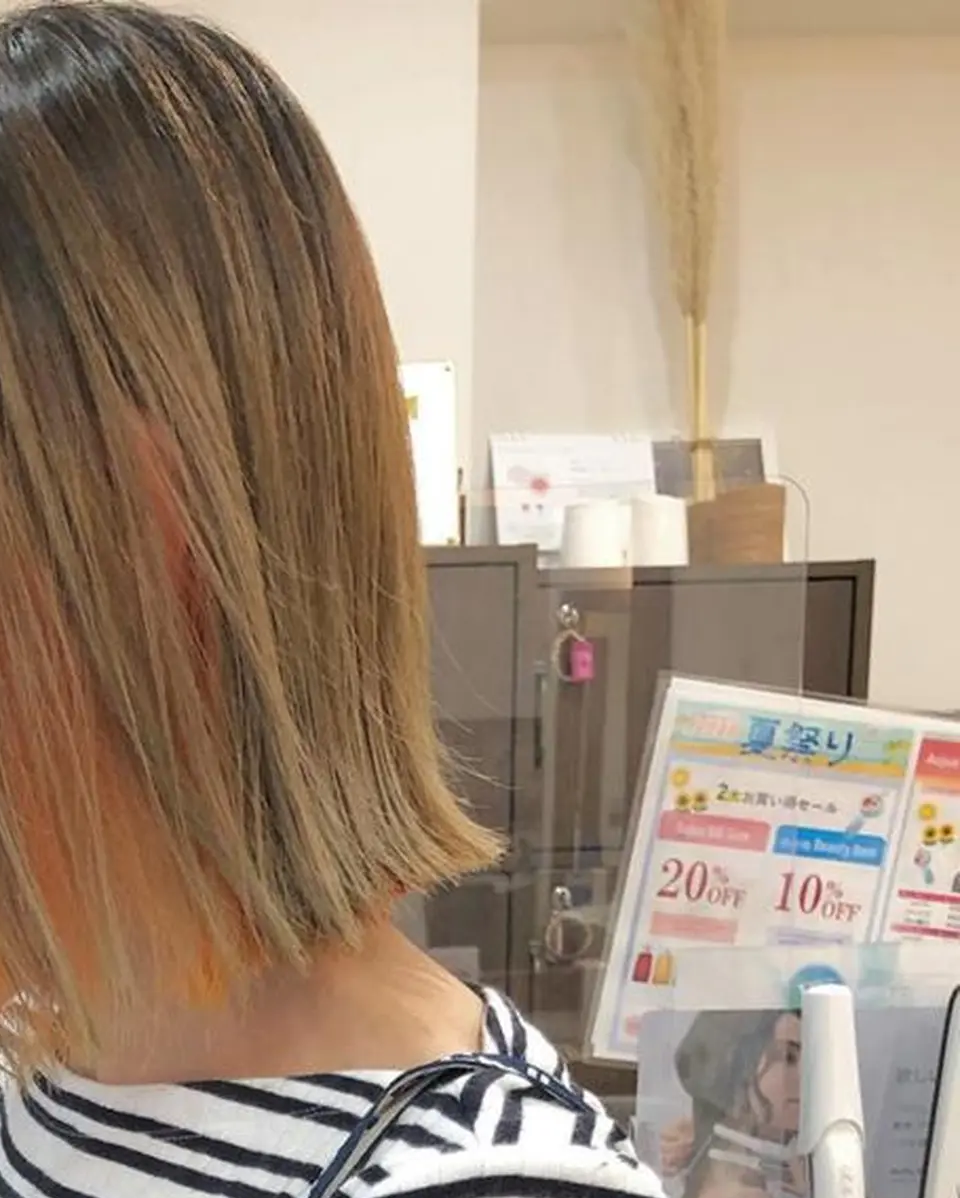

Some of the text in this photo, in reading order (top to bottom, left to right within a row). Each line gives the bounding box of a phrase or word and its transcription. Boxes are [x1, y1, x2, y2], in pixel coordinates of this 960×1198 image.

[740, 715, 853, 766] 夏祭り
[706, 885, 748, 909] OFF
[820, 902, 862, 923] OFF
